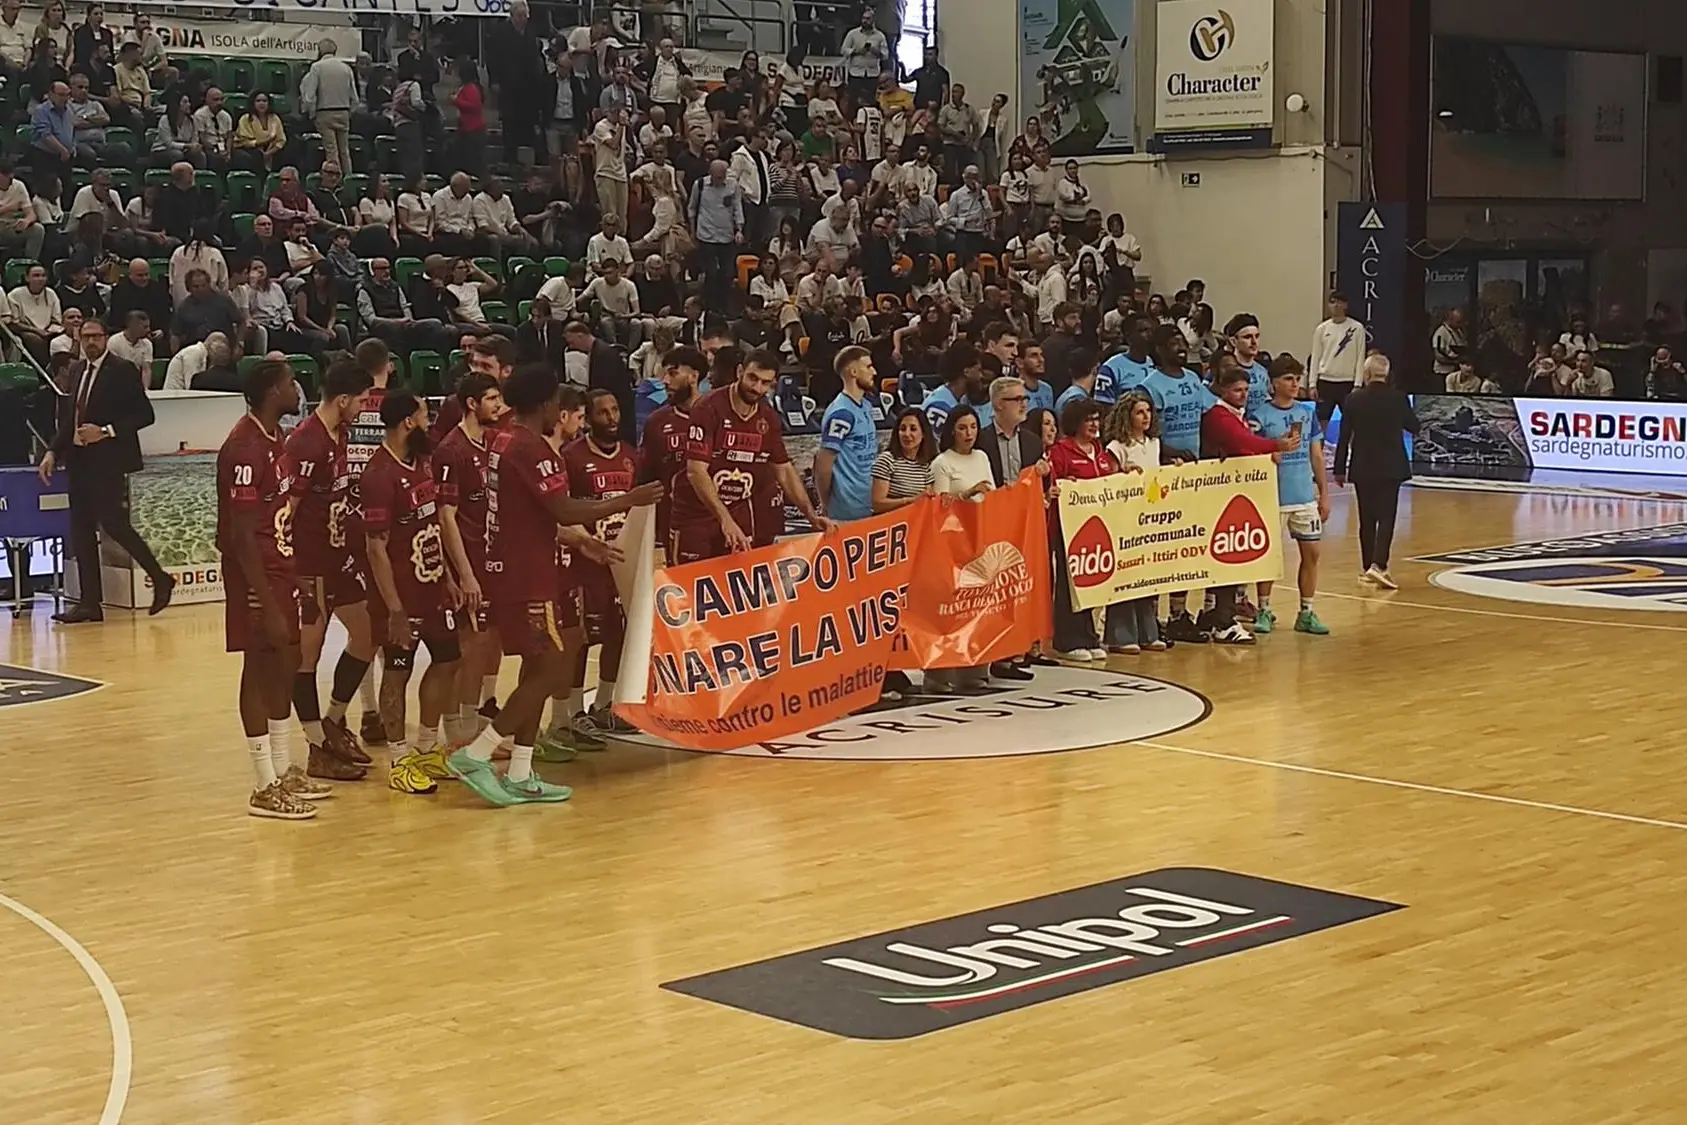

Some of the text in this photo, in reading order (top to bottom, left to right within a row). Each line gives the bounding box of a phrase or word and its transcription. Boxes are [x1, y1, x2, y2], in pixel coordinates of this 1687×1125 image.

[211, 34, 248, 48] ISOLA
[252, 33, 320, 54] dell'Artigian
[1167, 73, 1261, 96] Character
[1361, 235, 1381, 343] ACRIS
[1530, 411, 1687, 442] SARDEGN
[1531, 436, 1687, 460] sardegnaturismo.
[234, 465, 253, 485] 20
[299, 460, 315, 477] 11
[1098, 487, 1114, 507] gli
[1170, 476, 1180, 491] il
[1234, 469, 1242, 483] è
[1244, 469, 1268, 481] vita
[1138, 510, 1182, 526] Gruppo
[1118, 524, 1206, 551] Intercomunale
[1212, 521, 1267, 554] aido
[1068, 543, 1114, 577] aido
[1152, 549, 1178, 563] Ittiri
[1180, 545, 1208, 558] ODV
[655, 523, 909, 629] CAMPO PER
[652, 632, 780, 697] NARE
[788, 614, 843, 669] LA
[707, 701, 775, 735] contro
[780, 691, 802, 717] le
[808, 663, 884, 709] malattie
[755, 678, 1169, 756] ACRISURE
[821, 887, 1257, 988] Unipol
